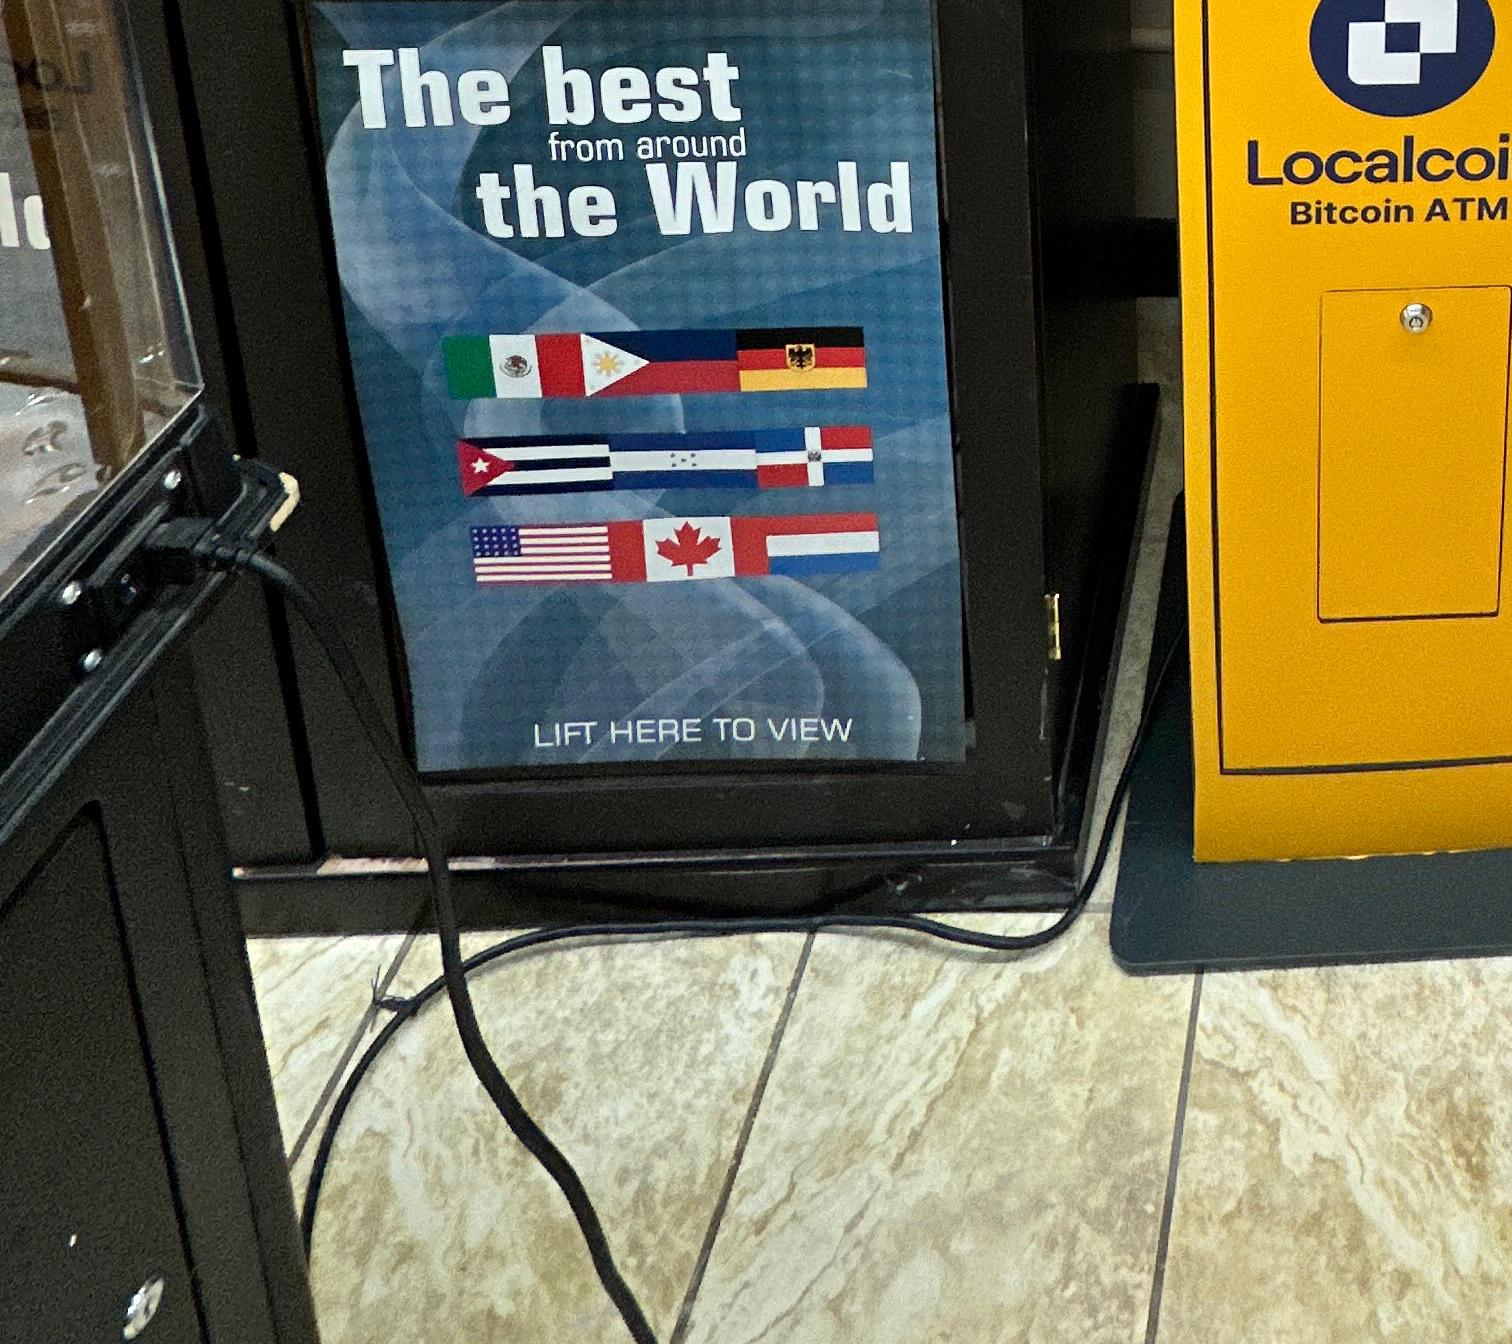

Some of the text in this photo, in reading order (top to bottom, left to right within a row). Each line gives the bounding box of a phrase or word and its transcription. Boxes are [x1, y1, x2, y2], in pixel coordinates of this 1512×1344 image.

[343, 46, 741, 128] The best
[549, 126, 747, 162] from around
[476, 161, 914, 238] the World
[1290, 197, 1509, 225] Bitcoin ATM
[534, 717, 853, 748] LIFT HERE TO VIEW
